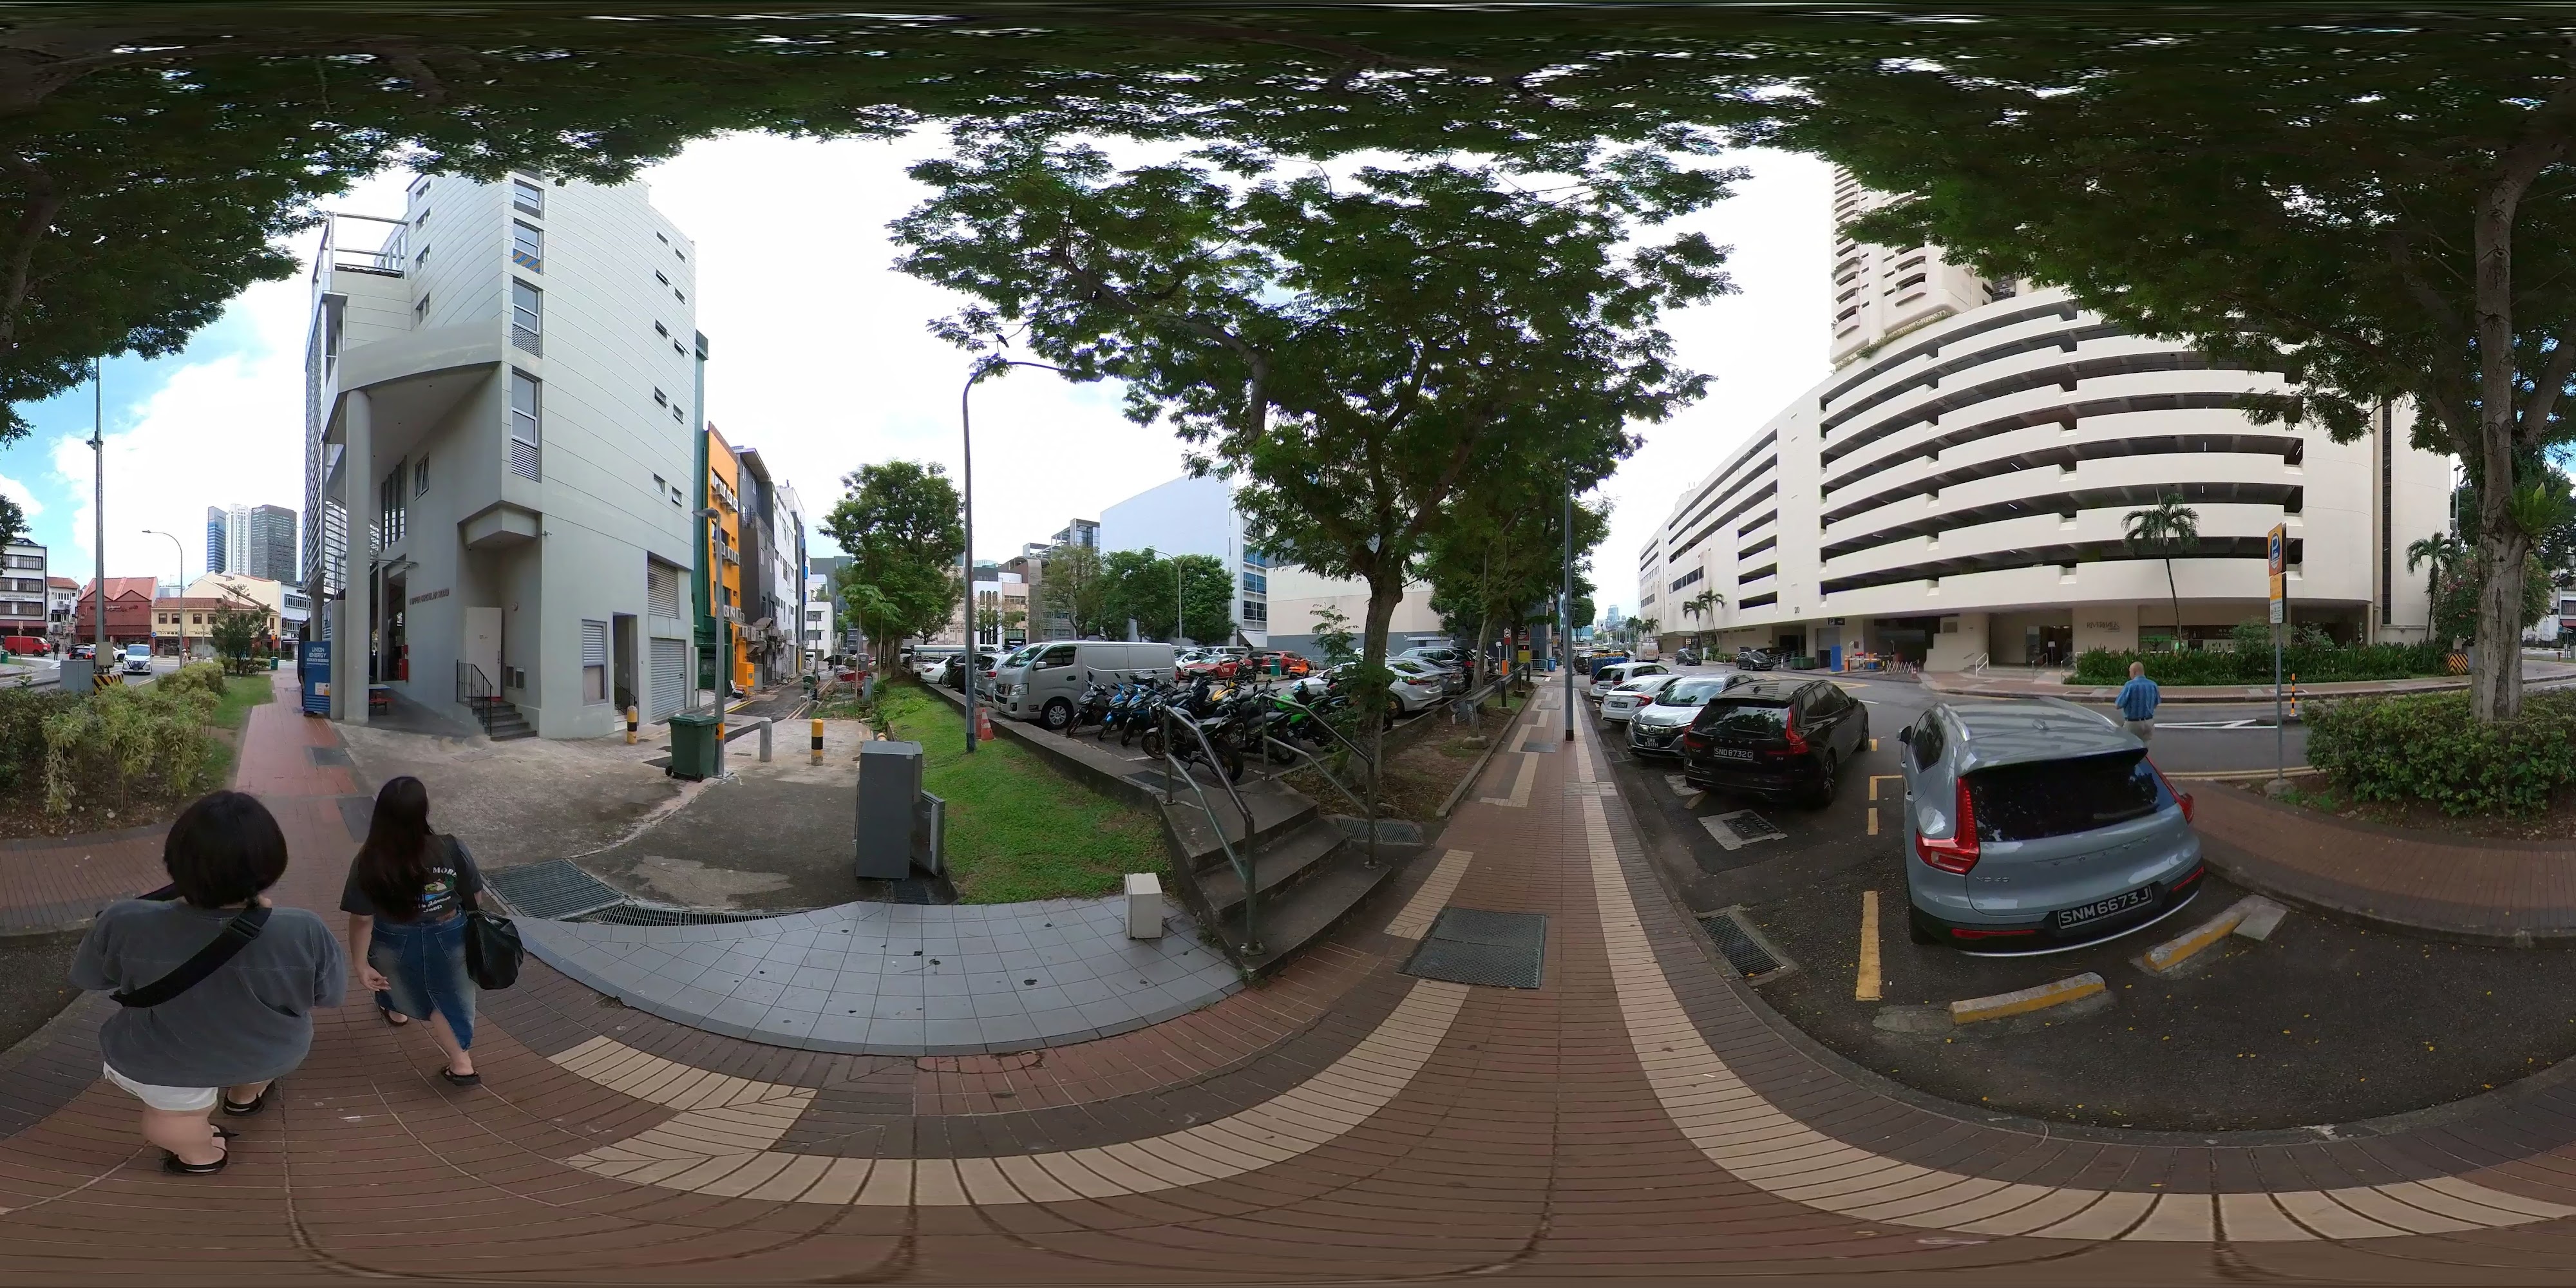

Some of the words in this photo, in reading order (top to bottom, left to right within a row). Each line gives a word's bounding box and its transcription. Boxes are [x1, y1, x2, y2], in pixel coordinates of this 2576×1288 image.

[421, 591, 438, 602] CIRCULAR
[438, 588, 450, 598] ROAD
[1715, 748, 1752, 758] SND8732G
[2060, 888, 2149, 923] SNM6673J
